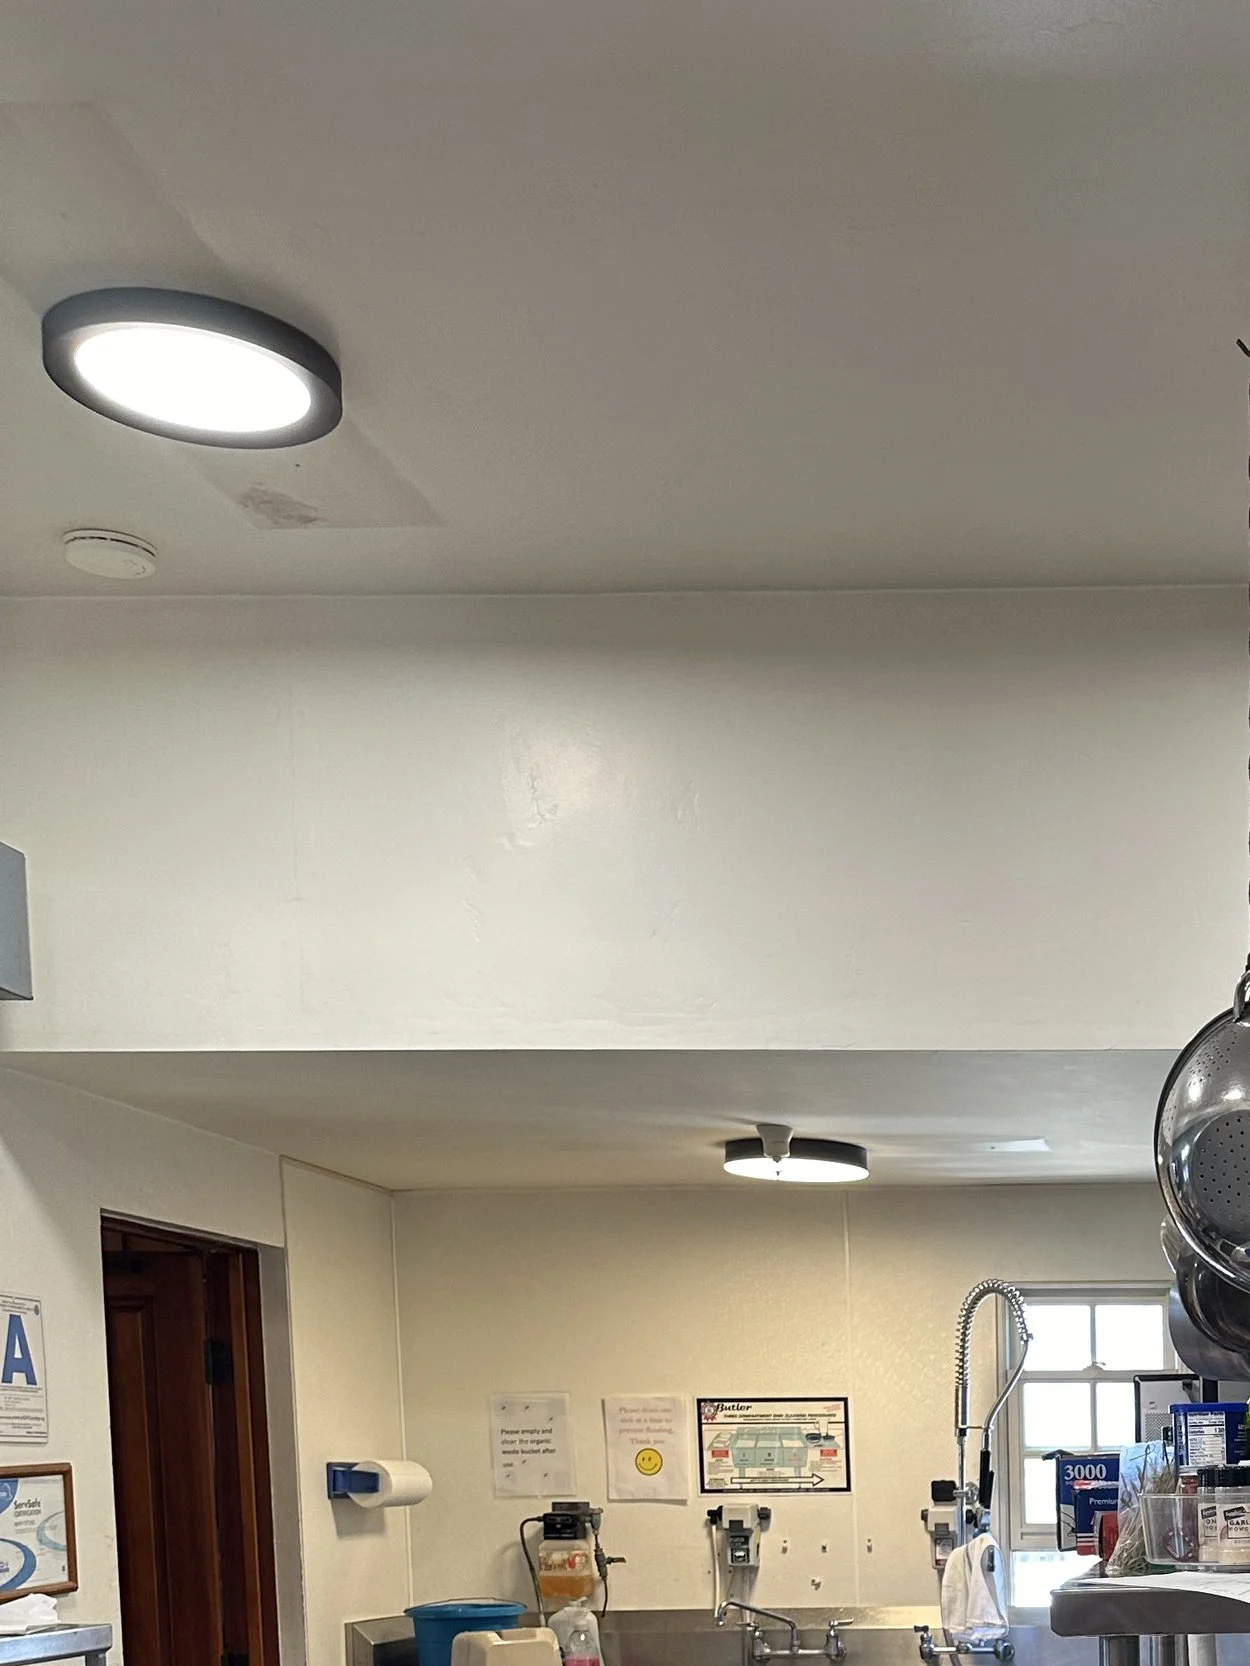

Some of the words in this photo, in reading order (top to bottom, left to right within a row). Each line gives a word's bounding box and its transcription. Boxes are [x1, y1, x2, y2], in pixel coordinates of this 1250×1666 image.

[1, 1313, 38, 1386] A
[717, 1403, 752, 1413] Butler
[1064, 1464, 1107, 1480] 3000
[14, 1498, 41, 1510] ServSafe
